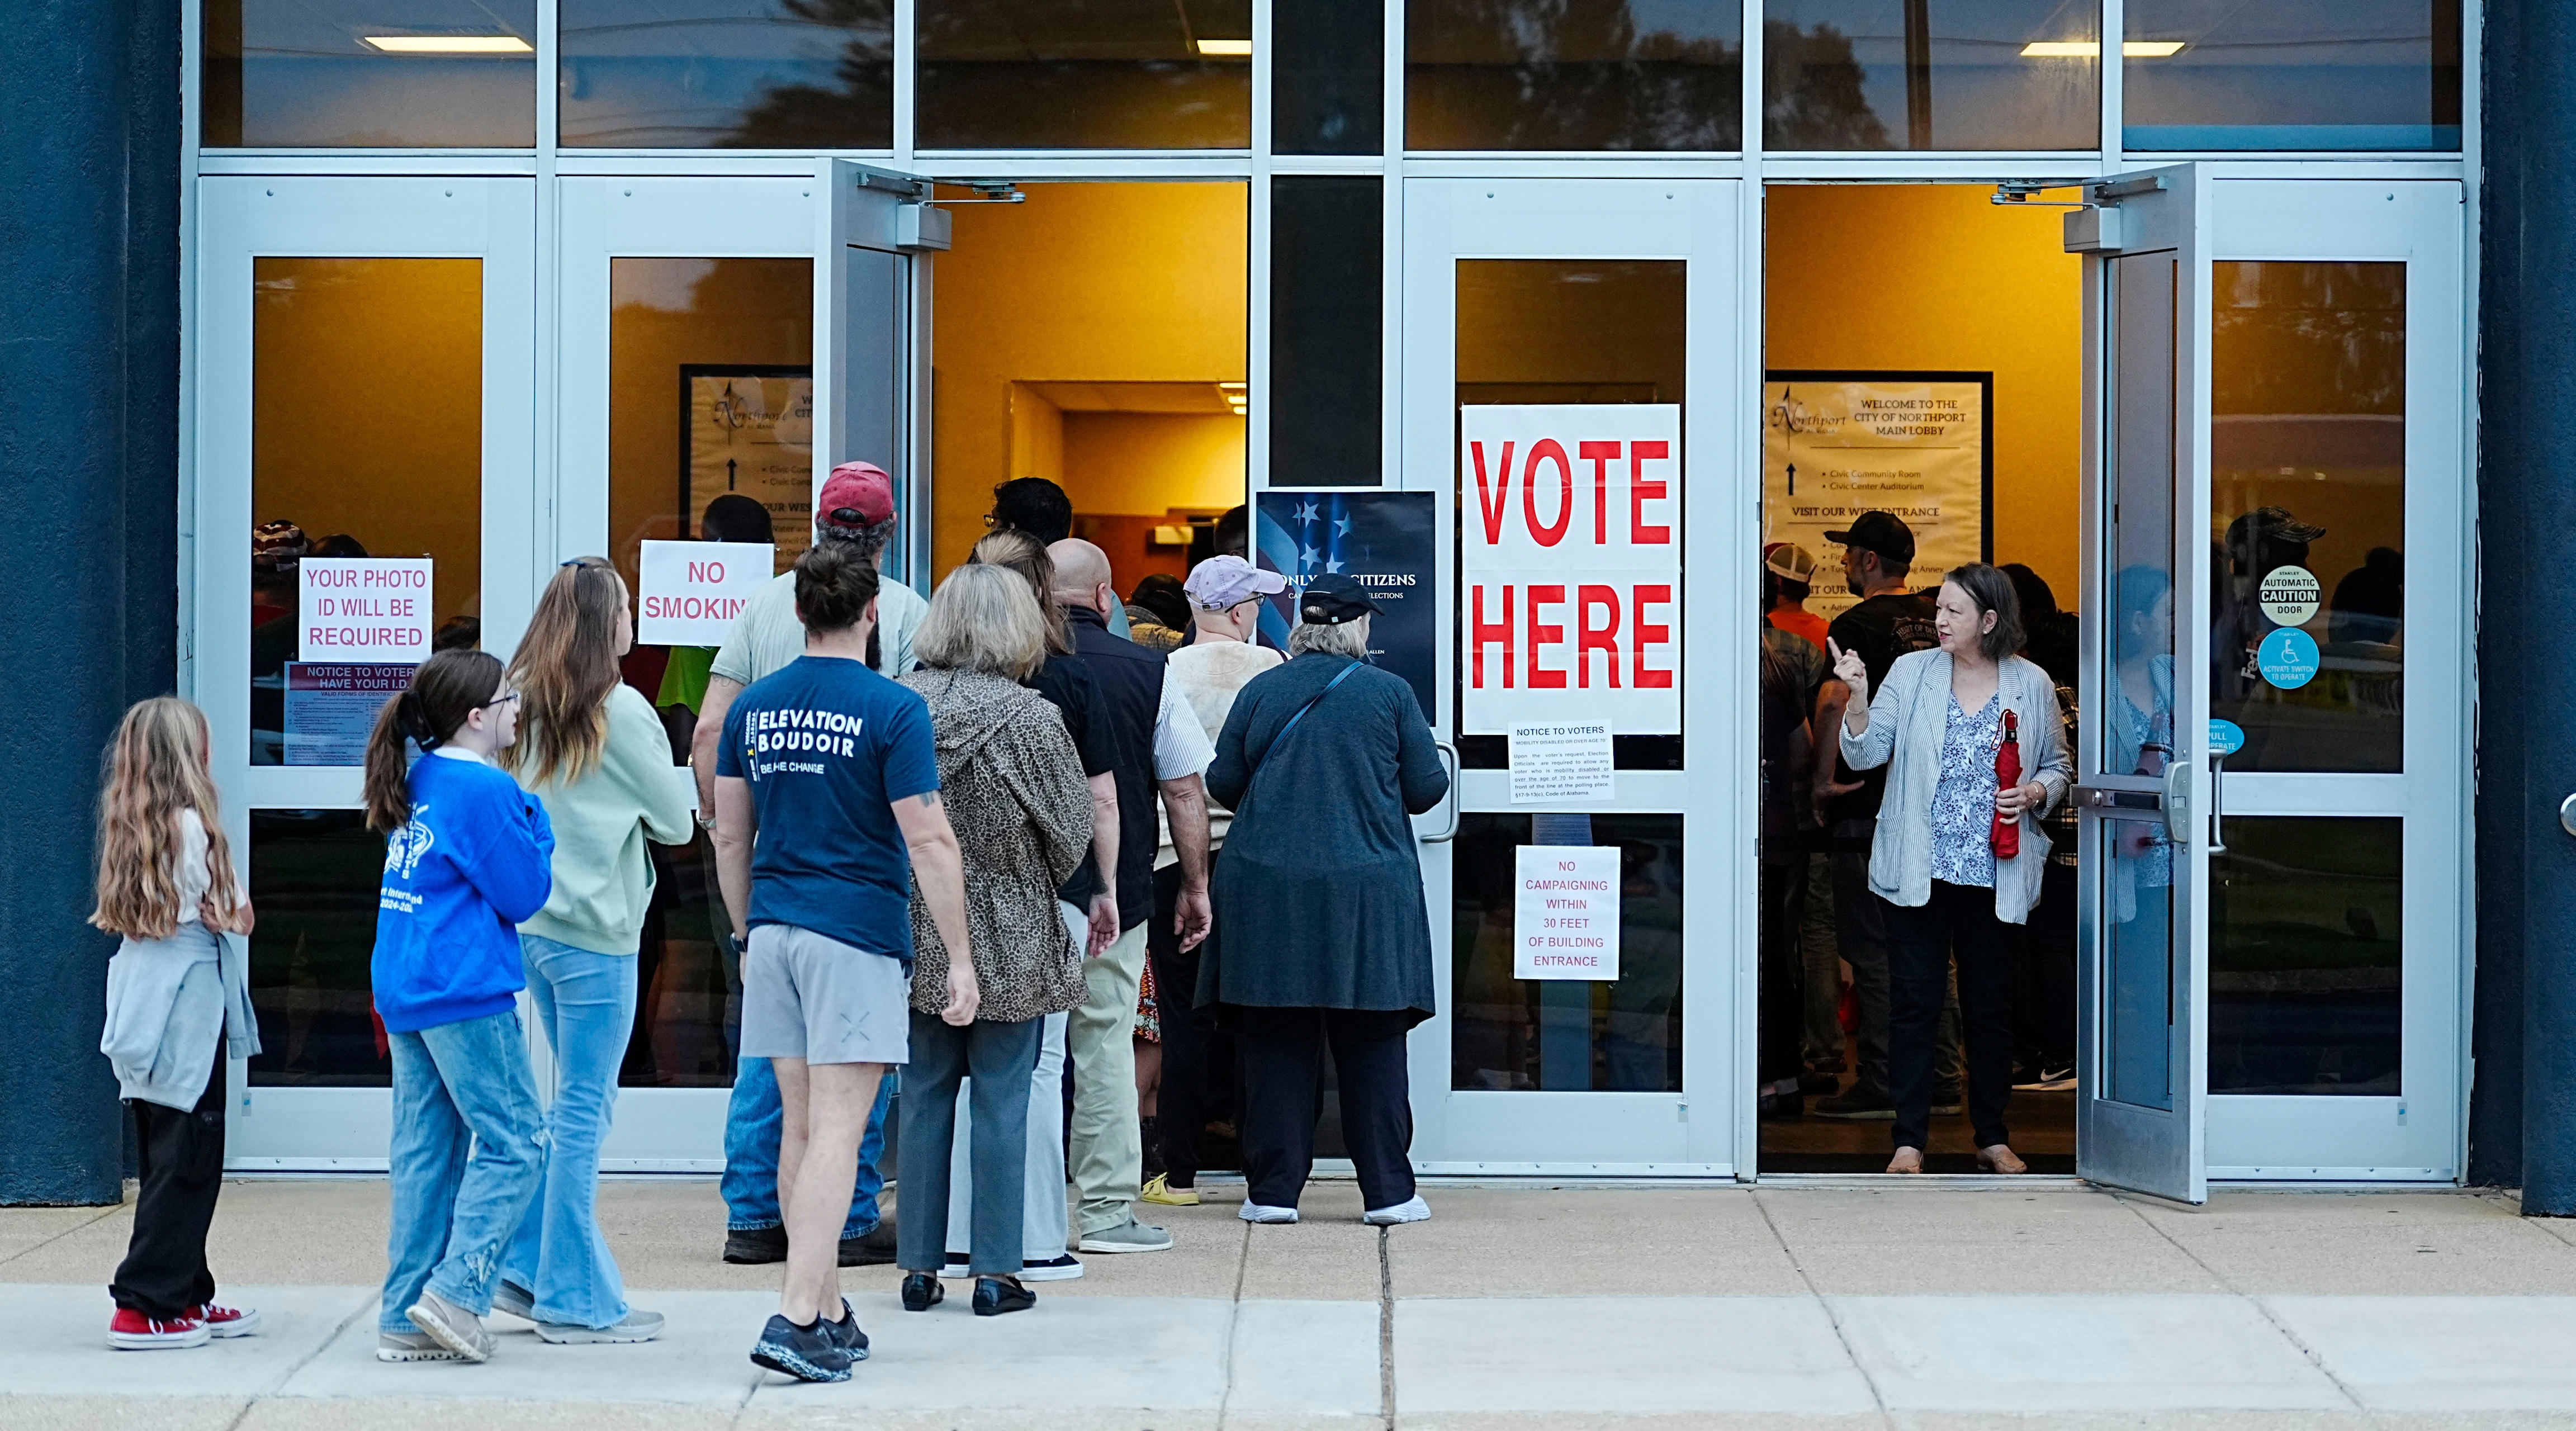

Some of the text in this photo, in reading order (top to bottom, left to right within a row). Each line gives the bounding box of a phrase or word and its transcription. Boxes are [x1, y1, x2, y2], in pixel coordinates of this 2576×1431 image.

[1861, 400, 1916, 408] WELCOME
[795, 409, 812, 418] CIT
[1854, 413, 1967, 422] CITY OF NORTHPORT
[1877, 427, 1944, 435] MAIN LOBBY
[1852, 470, 1896, 480] Community
[1470, 438, 1670, 547] VOTE
[789, 503, 811, 511] WES
[1792, 508, 1820, 516] VISIT
[1822, 508, 1845, 516] OUR
[689, 562, 724, 584] NO
[306, 570, 426, 587] YOUR PHOTO
[1824, 585, 1848, 594] OUR
[2261, 590, 2317, 601] CAUTION
[318, 599, 413, 617] ID WILL BE
[645, 596, 746, 620] SMOKIN
[309, 628, 423, 647] REQUIRED
[1472, 585, 1673, 688] HERE
[307, 667, 415, 677] NOTICE TO VOTER
[320, 679, 410, 689] HAVE YOUR I.D.
[759, 709, 863, 736] ELEVATION
[758, 732, 854, 757] BOUDOIR
[760, 764, 773, 774] BE
[773, 761, 787, 772] HE
[1559, 861, 1575, 871] NO
[1526, 880, 1608, 890] CAMPAIGNING
[411, 894, 423, 905] nd
[1546, 899, 1587, 909] WITHIN
[1543, 918, 1589, 928] 30 FEET
[1528, 937, 1603, 947] OF BUILDING
[1535, 956, 1598, 966] ENTRANCE
